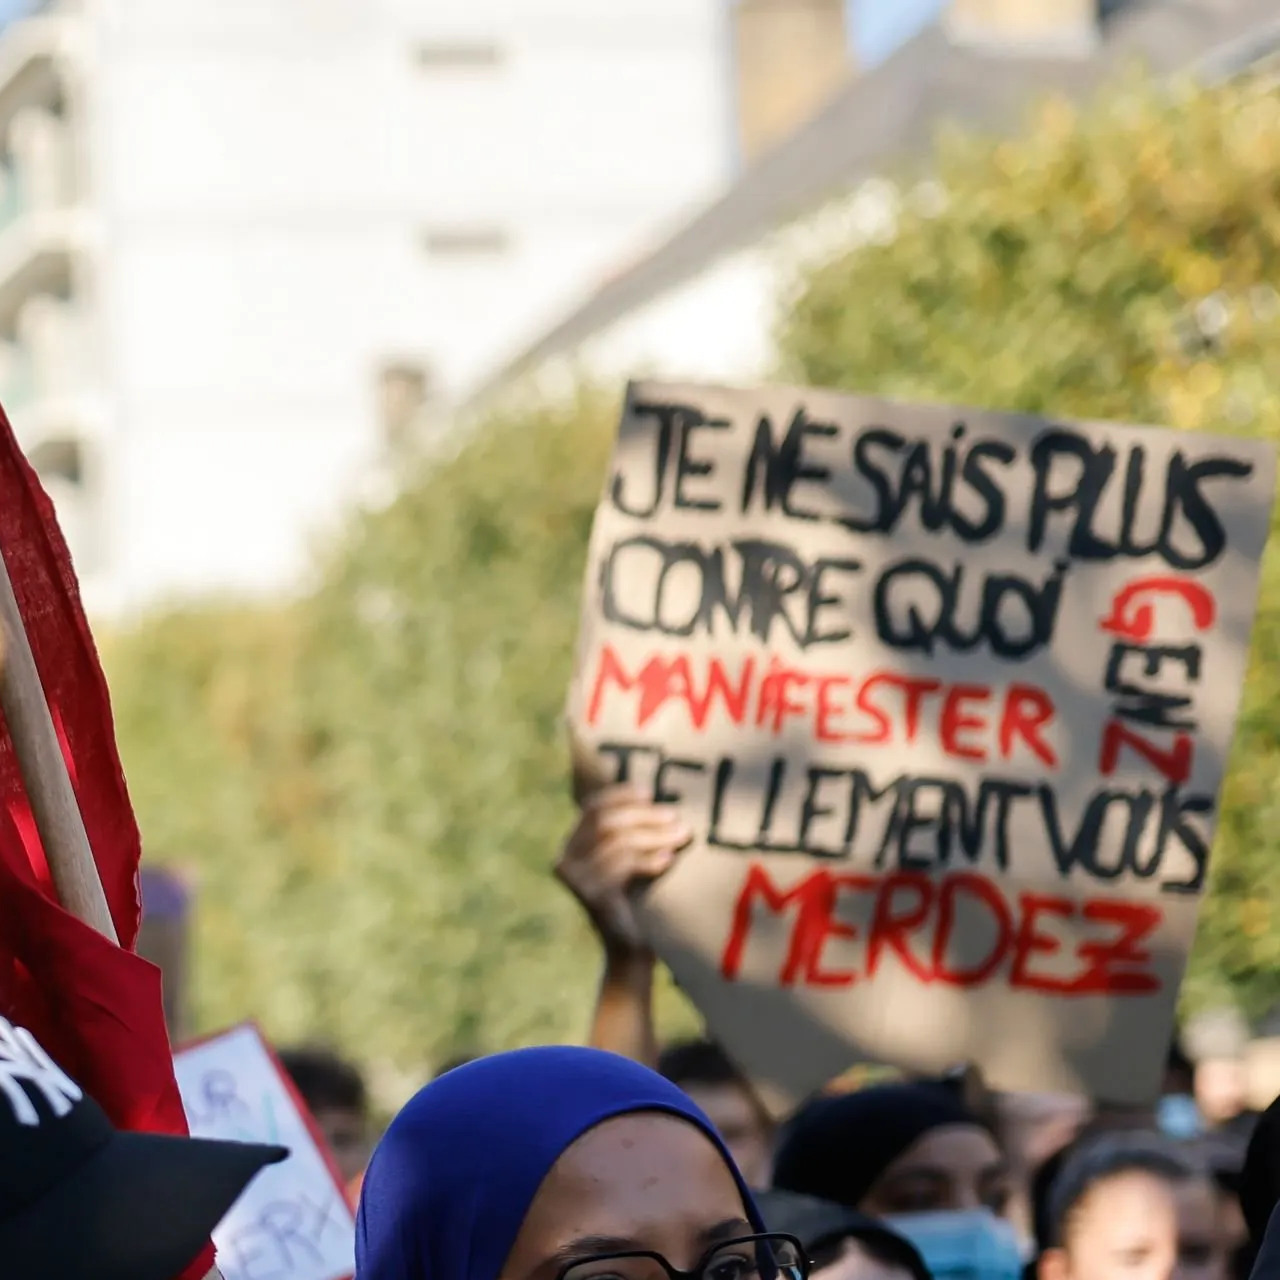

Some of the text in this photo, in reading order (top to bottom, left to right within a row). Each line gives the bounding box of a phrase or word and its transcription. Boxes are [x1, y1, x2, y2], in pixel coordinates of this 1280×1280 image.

[612, 402, 732, 520] JE
[739, 404, 838, 526] NE
[1027, 428, 1254, 570] PLUS
[598, 535, 860, 652] CONTRE
[597, 741, 1216, 895] TELLEMENT VOUS
[720, 860, 1163, 995] MERDEZ
